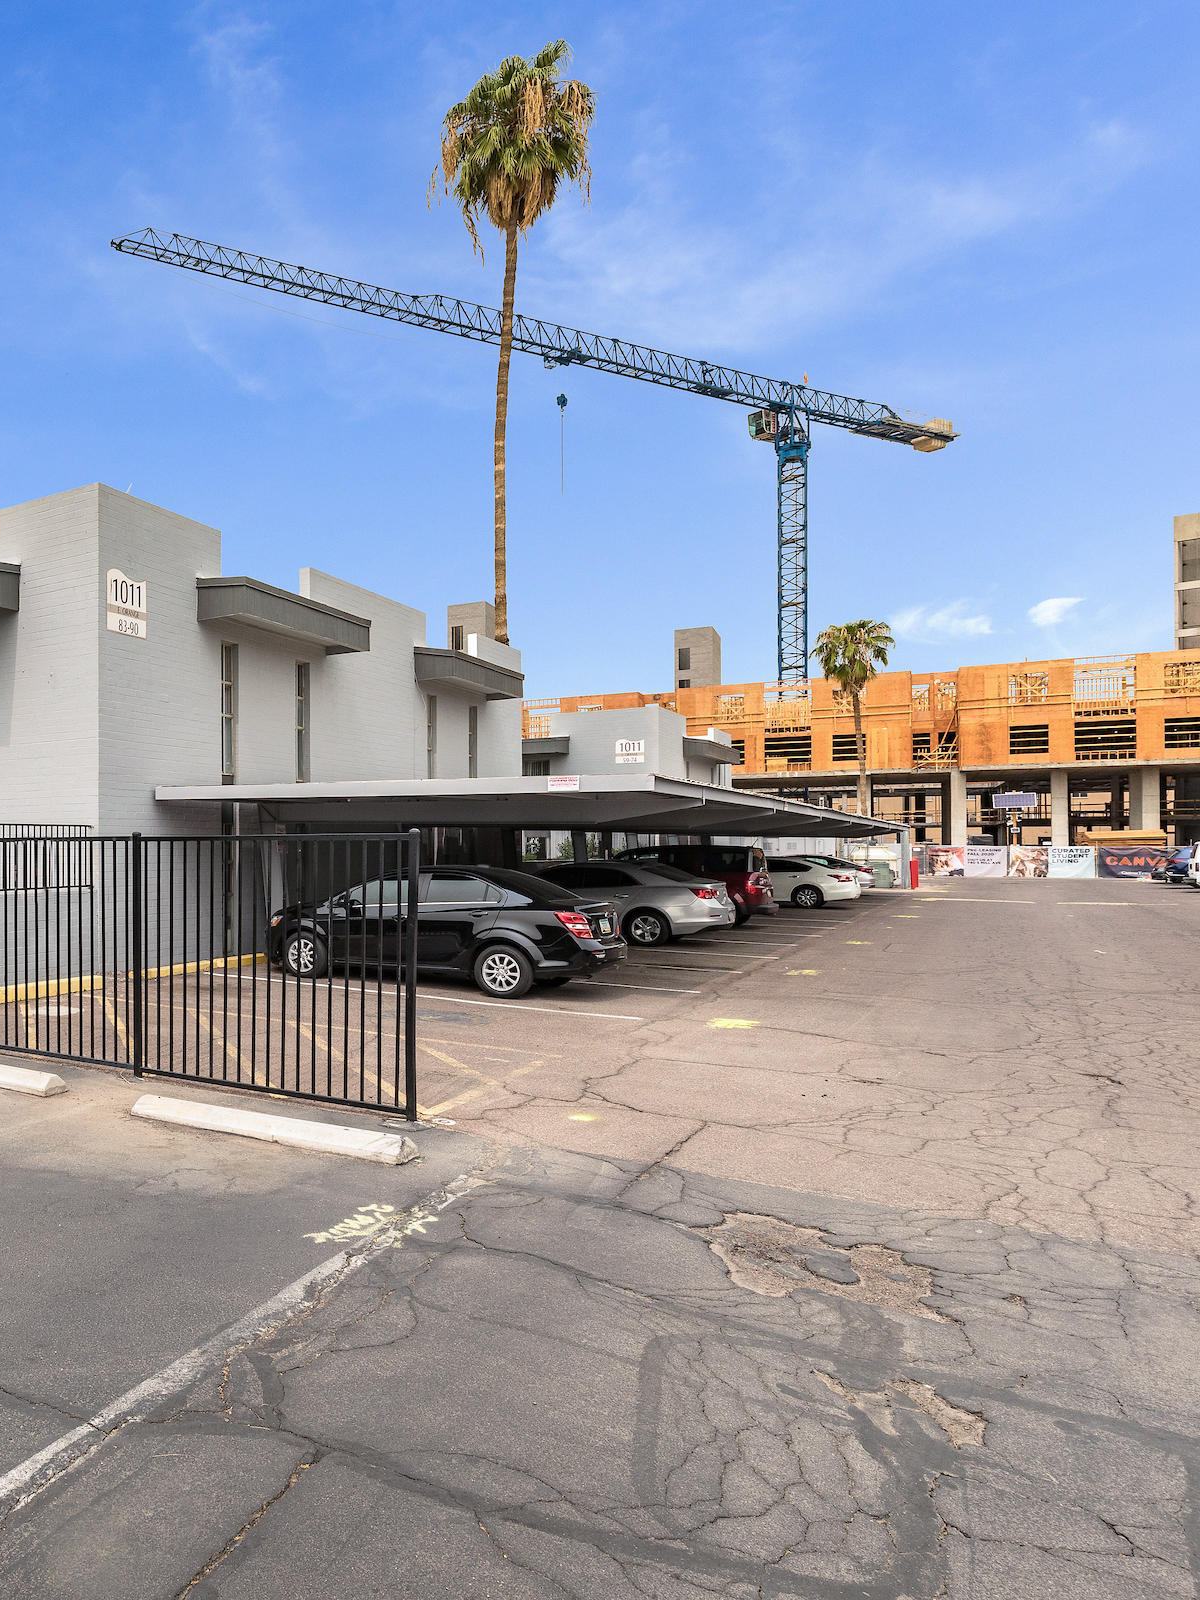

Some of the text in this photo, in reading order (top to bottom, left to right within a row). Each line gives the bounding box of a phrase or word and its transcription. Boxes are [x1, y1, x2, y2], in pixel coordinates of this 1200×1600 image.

[113, 579, 141, 608] 1011
[121, 607, 140, 618] ORANGE
[118, 618, 139, 635] 83-90
[619, 742, 640, 752] 1011
[1105, 856, 1167, 866] CANVA
